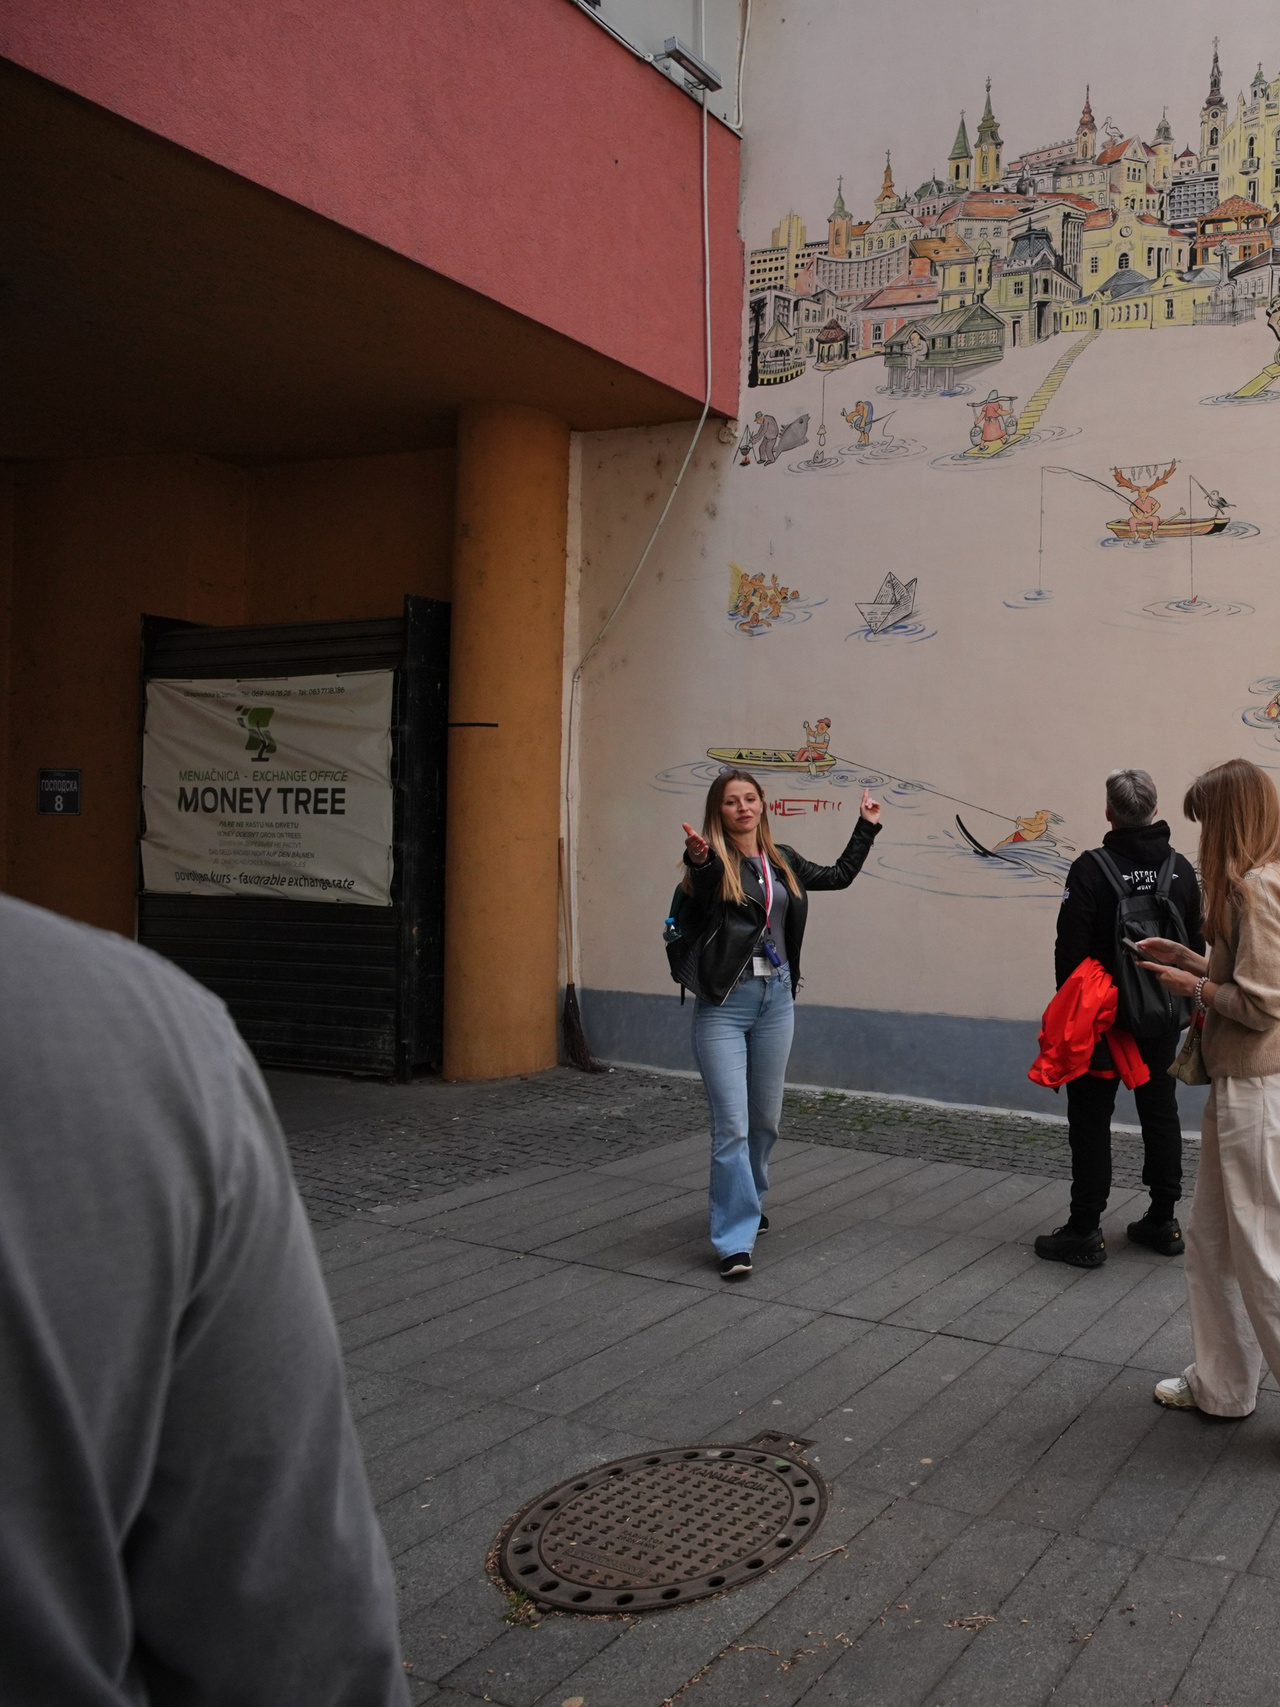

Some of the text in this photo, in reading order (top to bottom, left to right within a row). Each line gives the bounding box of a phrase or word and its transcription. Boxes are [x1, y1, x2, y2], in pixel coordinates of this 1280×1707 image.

[178, 768, 240, 782] MENJAČNICA
[252, 770, 307, 782] EXCHANGE
[309, 770, 349, 782] OFFICE
[41, 779, 78, 793] ГОСПОДСКА
[54, 794, 64, 811] 8
[177, 786, 346, 815] MONEY TREE
[275, 821, 299, 829] DRVETU
[260, 831, 276, 839] GROW
[285, 832, 301, 840] TREES
[174, 870, 210, 884] povoljan
[210, 870, 231, 884] kurs
[239, 872, 287, 886] favorable
[287, 874, 332, 890] exchange
[332, 878, 355, 890] rate
[688, 1466, 769, 1493] KANALIZACIJA
